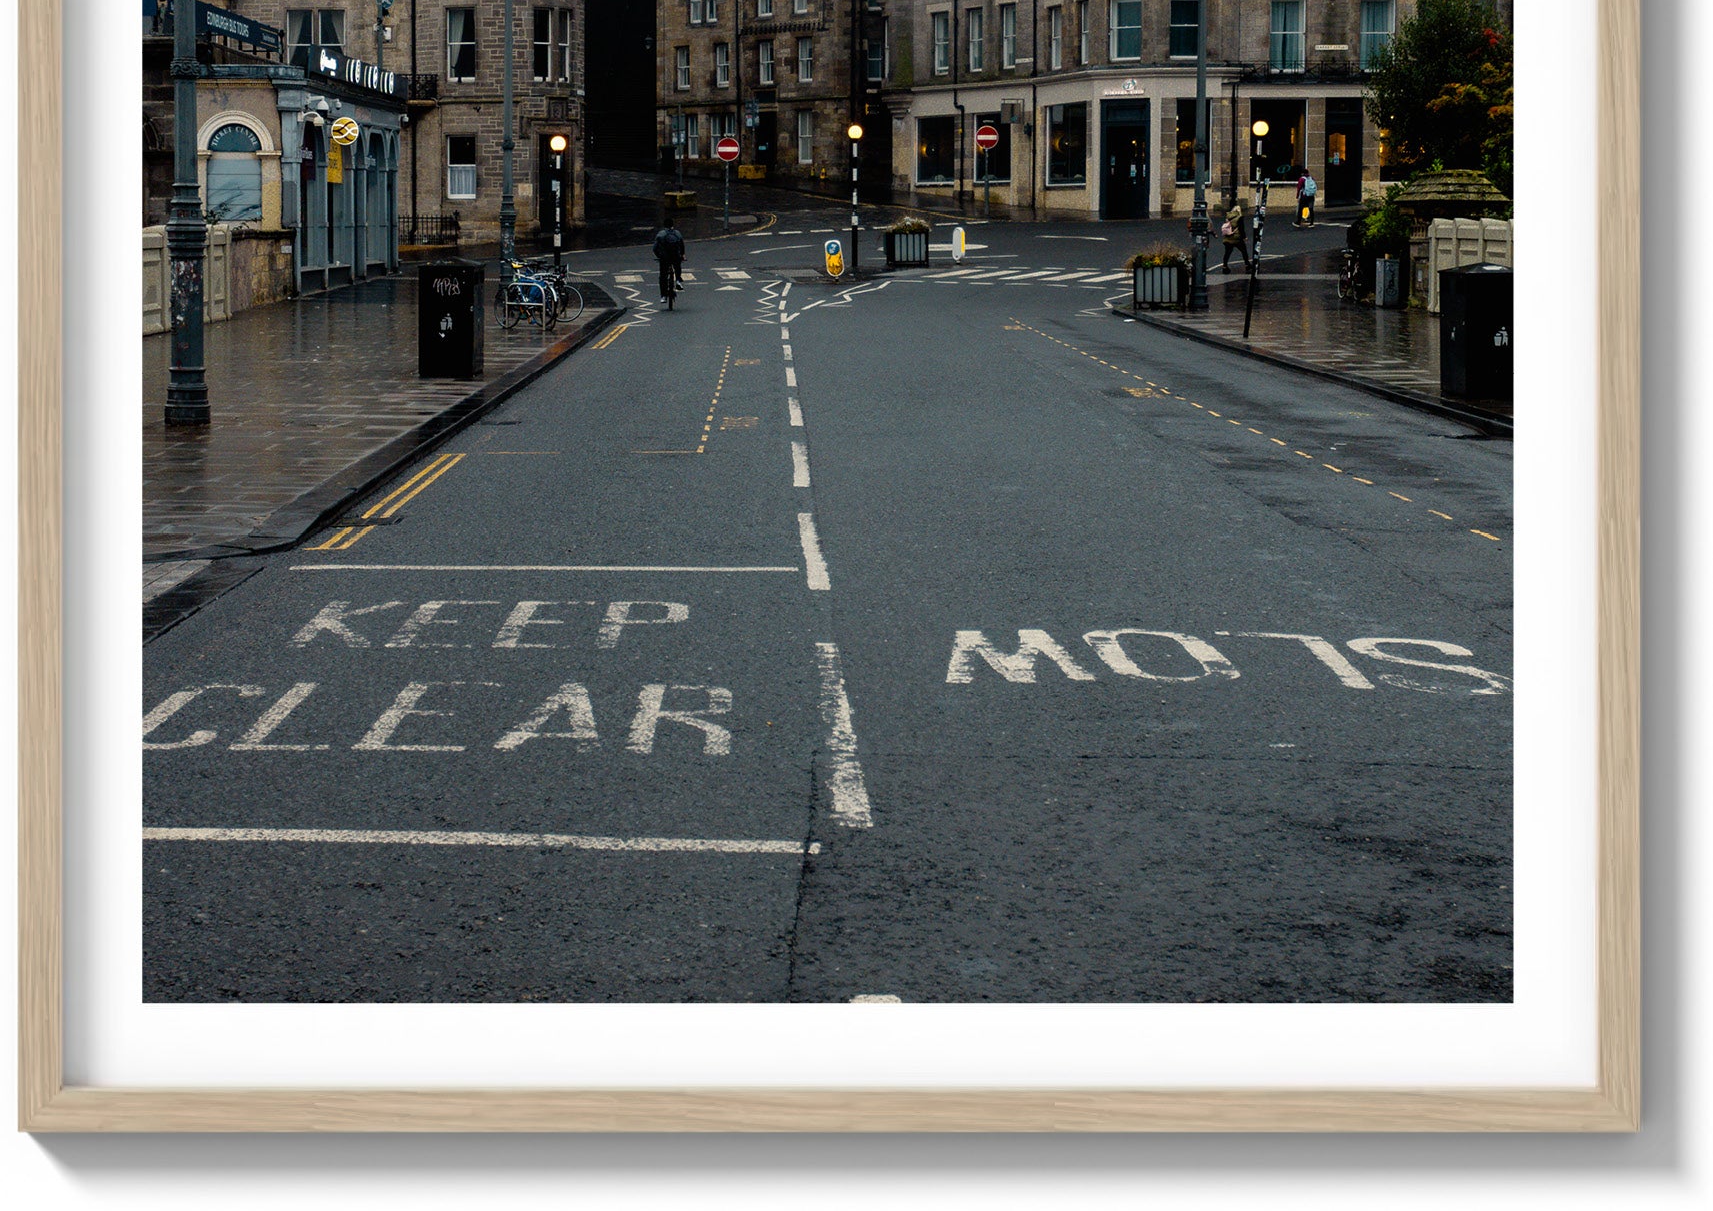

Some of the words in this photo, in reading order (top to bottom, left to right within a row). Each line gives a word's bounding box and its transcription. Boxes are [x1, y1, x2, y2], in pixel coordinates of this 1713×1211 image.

[207, 11, 229, 30] EDINBURGH
[229, 19, 237, 33] BUS
[237, 22, 249, 38] TOURS
[211, 126, 232, 146] TICKET
[235, 126, 259, 146] CENTRE
[289, 600, 690, 649] KEEP
[945, 628, 1514, 695] SLOW
[142, 680, 733, 756] CLEAR
